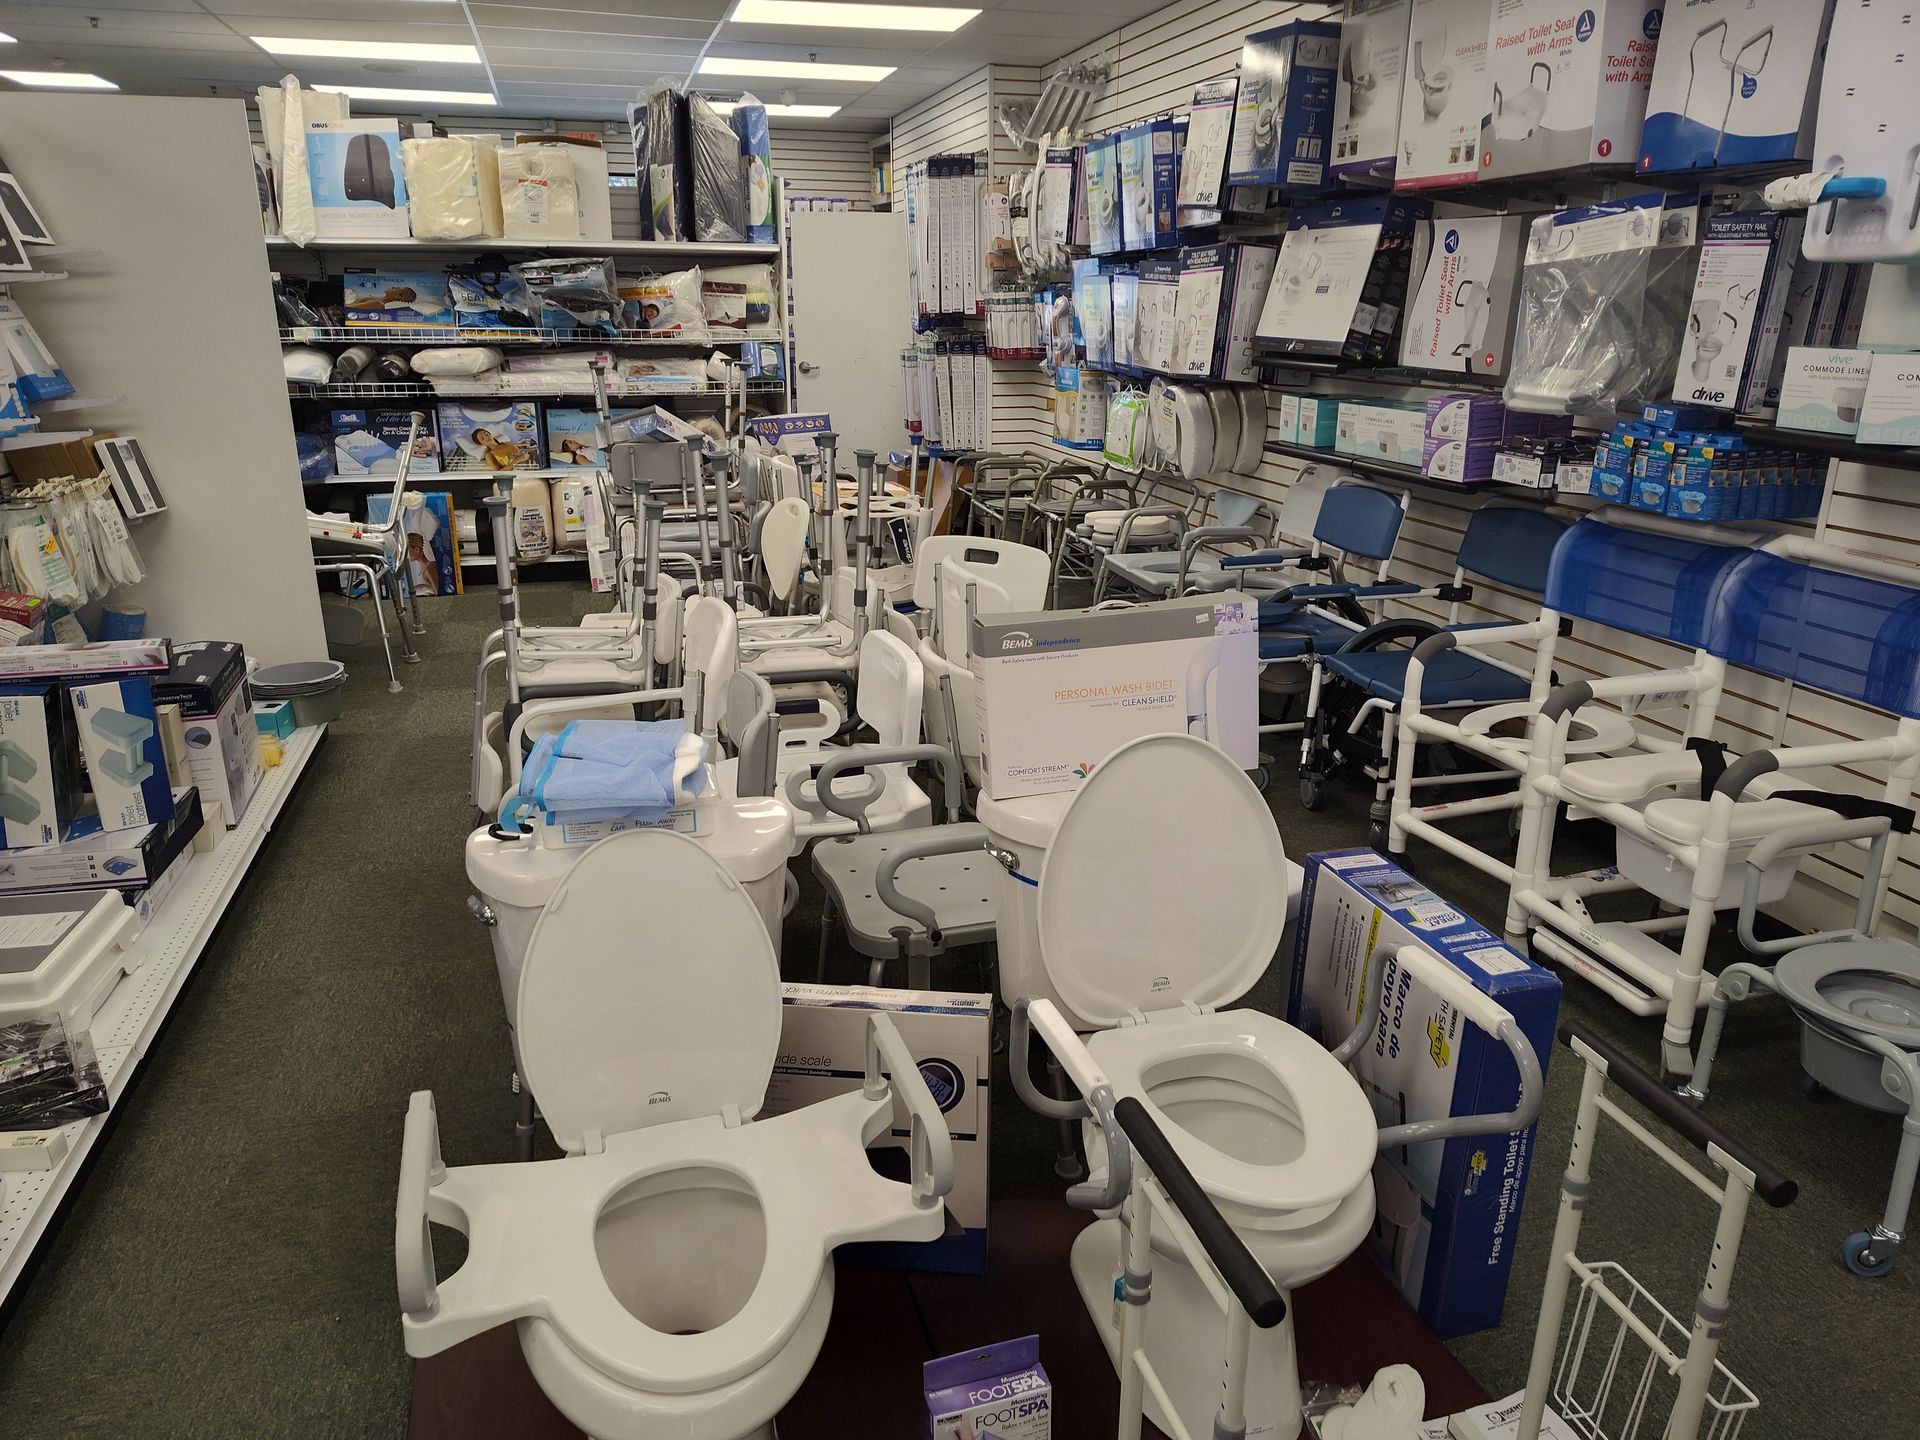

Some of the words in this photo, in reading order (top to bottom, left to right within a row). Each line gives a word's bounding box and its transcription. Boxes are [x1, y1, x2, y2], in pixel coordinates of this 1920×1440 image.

[1496, 30, 1526, 49] Raised
[1528, 24, 1552, 40] Toilet
[1555, 16, 1575, 32] Seat
[1528, 41, 1545, 56] with
[1548, 36, 1573, 51] Arms
[1628, 40, 1657, 52] Raise
[1607, 57, 1636, 67] Toilet
[1605, 73, 1627, 82] with
[1631, 71, 1652, 82] Arm
[1196, 192, 1213, 203] drive
[1441, 255, 1450, 282] Seat
[1448, 256, 1457, 290] Arms
[1435, 284, 1446, 318] Toilet
[1430, 322, 1442, 358] Raised
[1189, 362, 1205, 371] drive
[1828, 354, 1853, 364] vive
[1803, 365, 1845, 374] COMMODE
[1692, 388, 1724, 403] drive
[1002, 638, 1033, 650] BEMIS
[1036, 637, 1080, 647] Independence
[1054, 688, 1110, 701] PERSONAL
[1112, 684, 1142, 695] WASH
[1146, 680, 1173, 691] BIDET
[4, 701, 14, 722] toilet
[1008, 768, 1041, 777] COMFORT
[1042, 765, 1067, 773] STREAM
[125, 806, 136, 825] toilet
[133, 792, 145, 823] footrest
[1369, 918, 1379, 941] Altura
[1428, 915, 1461, 927] GREAT
[1391, 969, 1414, 1031] Marco
[1439, 999, 1450, 1014] TH
[1371, 1009, 1391, 1057] para
[1431, 1013, 1449, 1060] SAFETY
[1388, 1033, 1403, 1060] de
[800, 1055, 831, 1066] scale
[648, 1094, 672, 1105] BEMIS
[1503, 1138, 1520, 1175] Toilet
[1519, 1140, 1527, 1156] para
[1515, 1157, 1524, 1180] apoyo
[1512, 1182, 1520, 1192] de
[1494, 1176, 1515, 1234] Standing
[1508, 1193, 1517, 1213] Marco
[1488, 1236, 1502, 1265] Free
[1001, 1370, 1037, 1384] Massaging
[1011, 1393, 1048, 1406] Massaging
